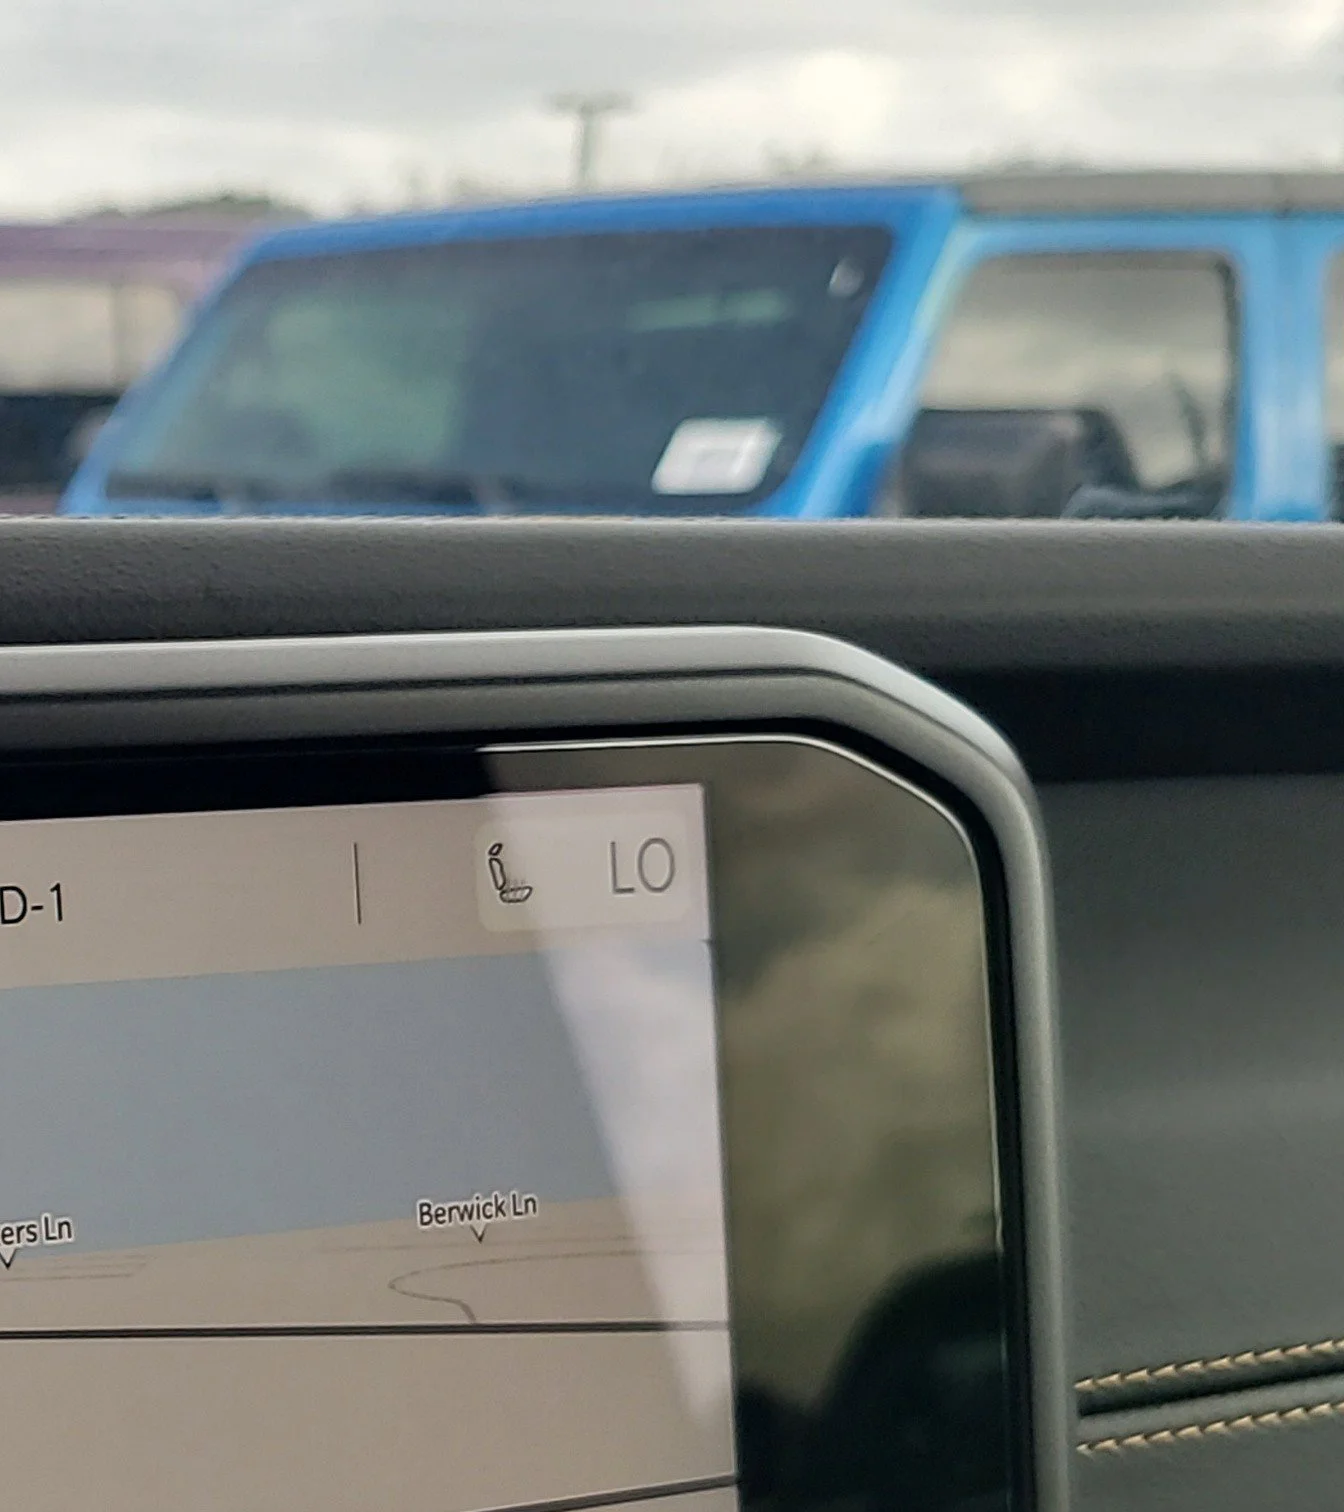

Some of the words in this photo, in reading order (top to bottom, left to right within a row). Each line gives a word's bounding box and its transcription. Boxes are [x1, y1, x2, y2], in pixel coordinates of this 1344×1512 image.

[610, 836, 677, 895] LO
[419, 1193, 506, 1226] Berwick
[512, 1193, 537, 1216] Ln
[44, 1216, 72, 1240] Ln
